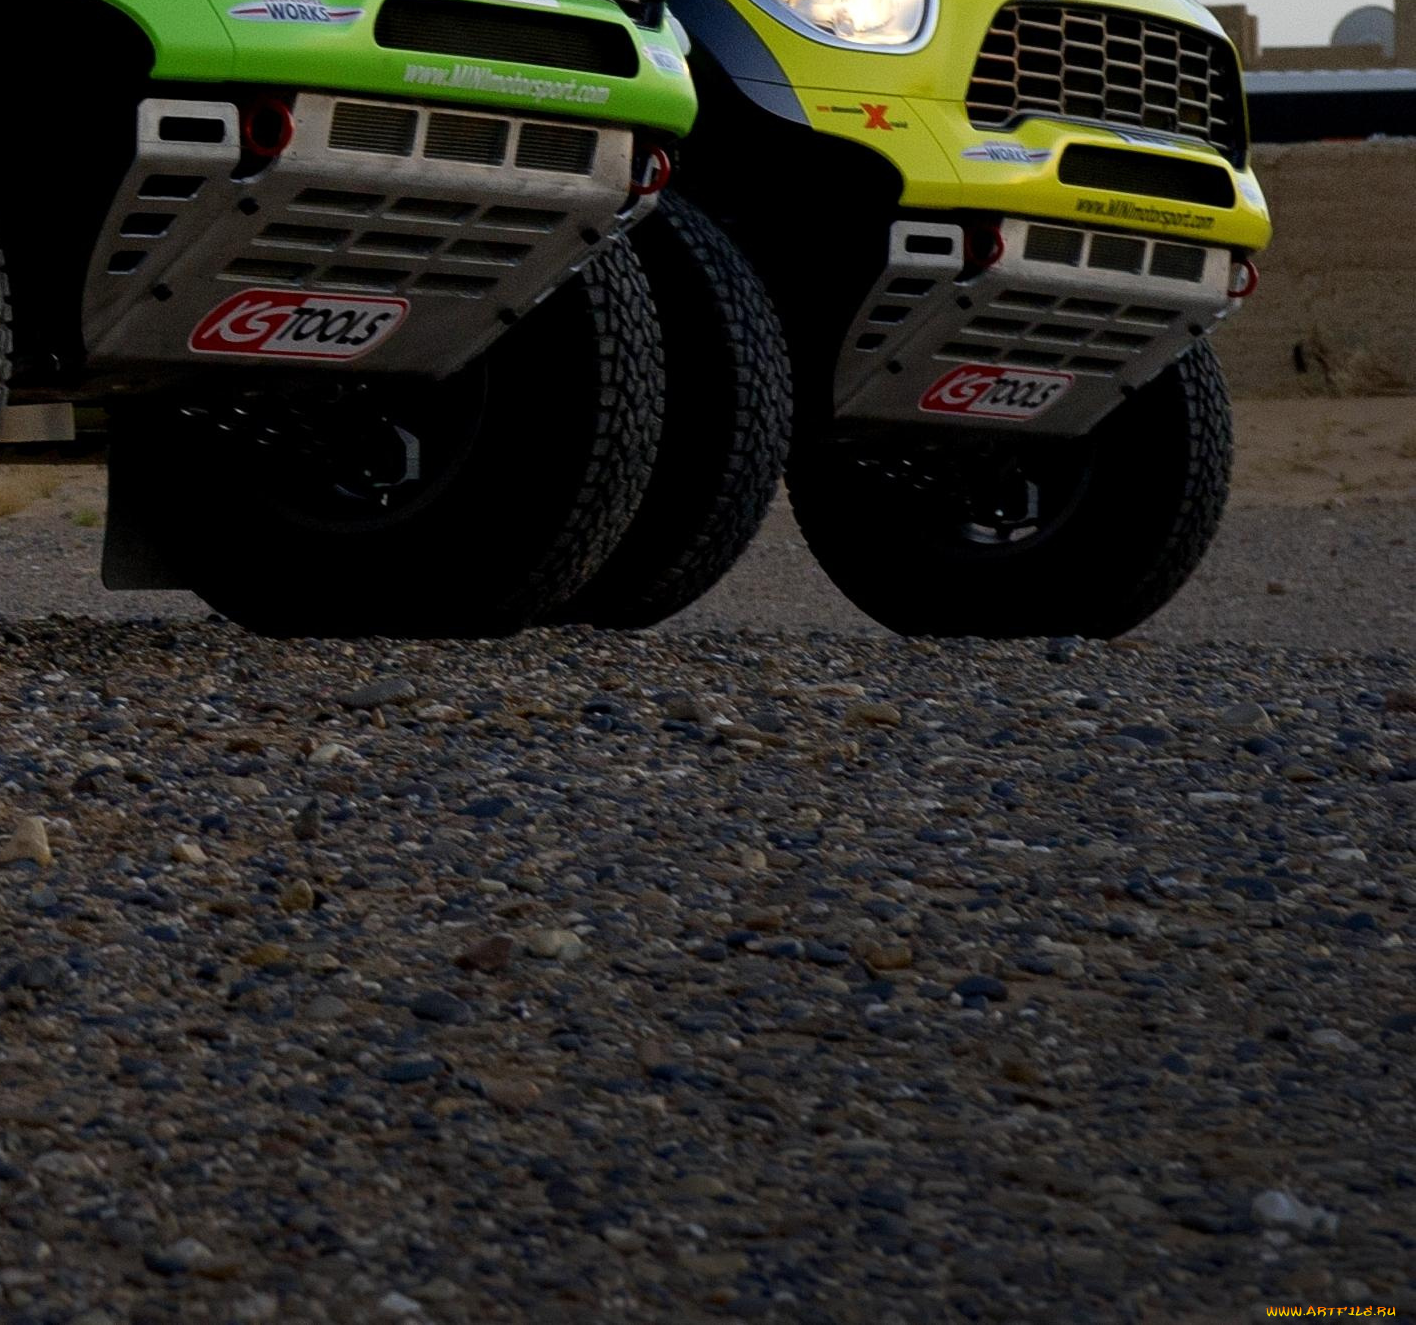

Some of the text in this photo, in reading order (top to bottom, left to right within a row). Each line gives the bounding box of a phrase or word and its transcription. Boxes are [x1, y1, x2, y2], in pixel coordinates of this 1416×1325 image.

[265, 3, 330, 23] WORKS
[403, 64, 610, 105] www.MINImotorsport.com
[276, 307, 392, 346] TOOLS
[979, 378, 1061, 408] TOOLS
